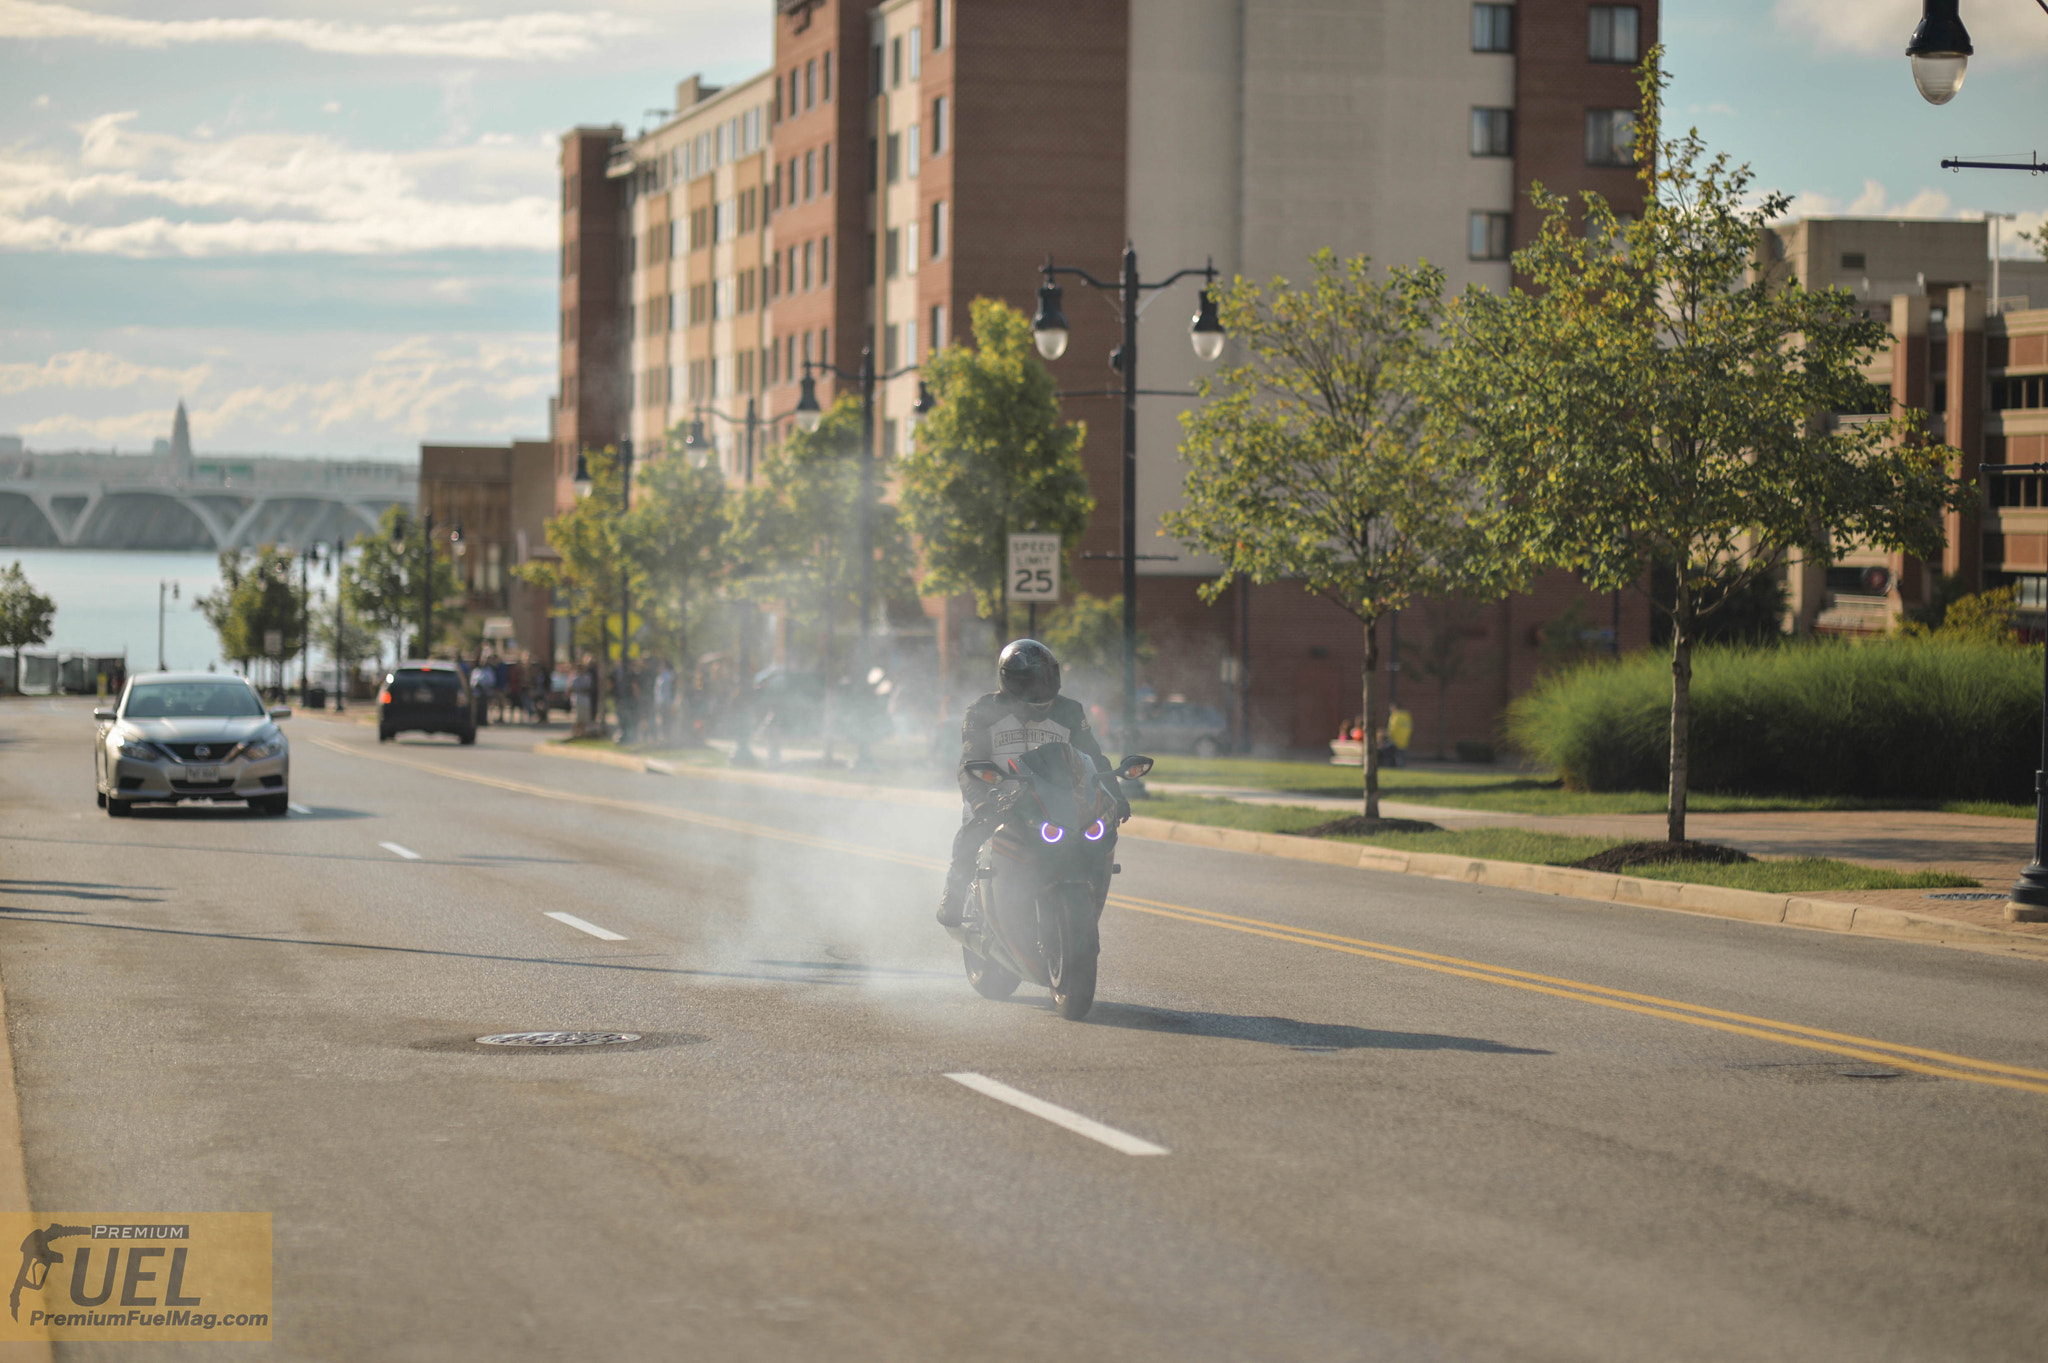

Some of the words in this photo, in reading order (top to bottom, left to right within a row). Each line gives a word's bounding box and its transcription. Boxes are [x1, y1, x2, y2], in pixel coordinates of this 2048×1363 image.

[1013, 542, 1055, 553] SPEED
[1016, 556, 1051, 567] LIMIT
[1015, 569, 1053, 593] 25
